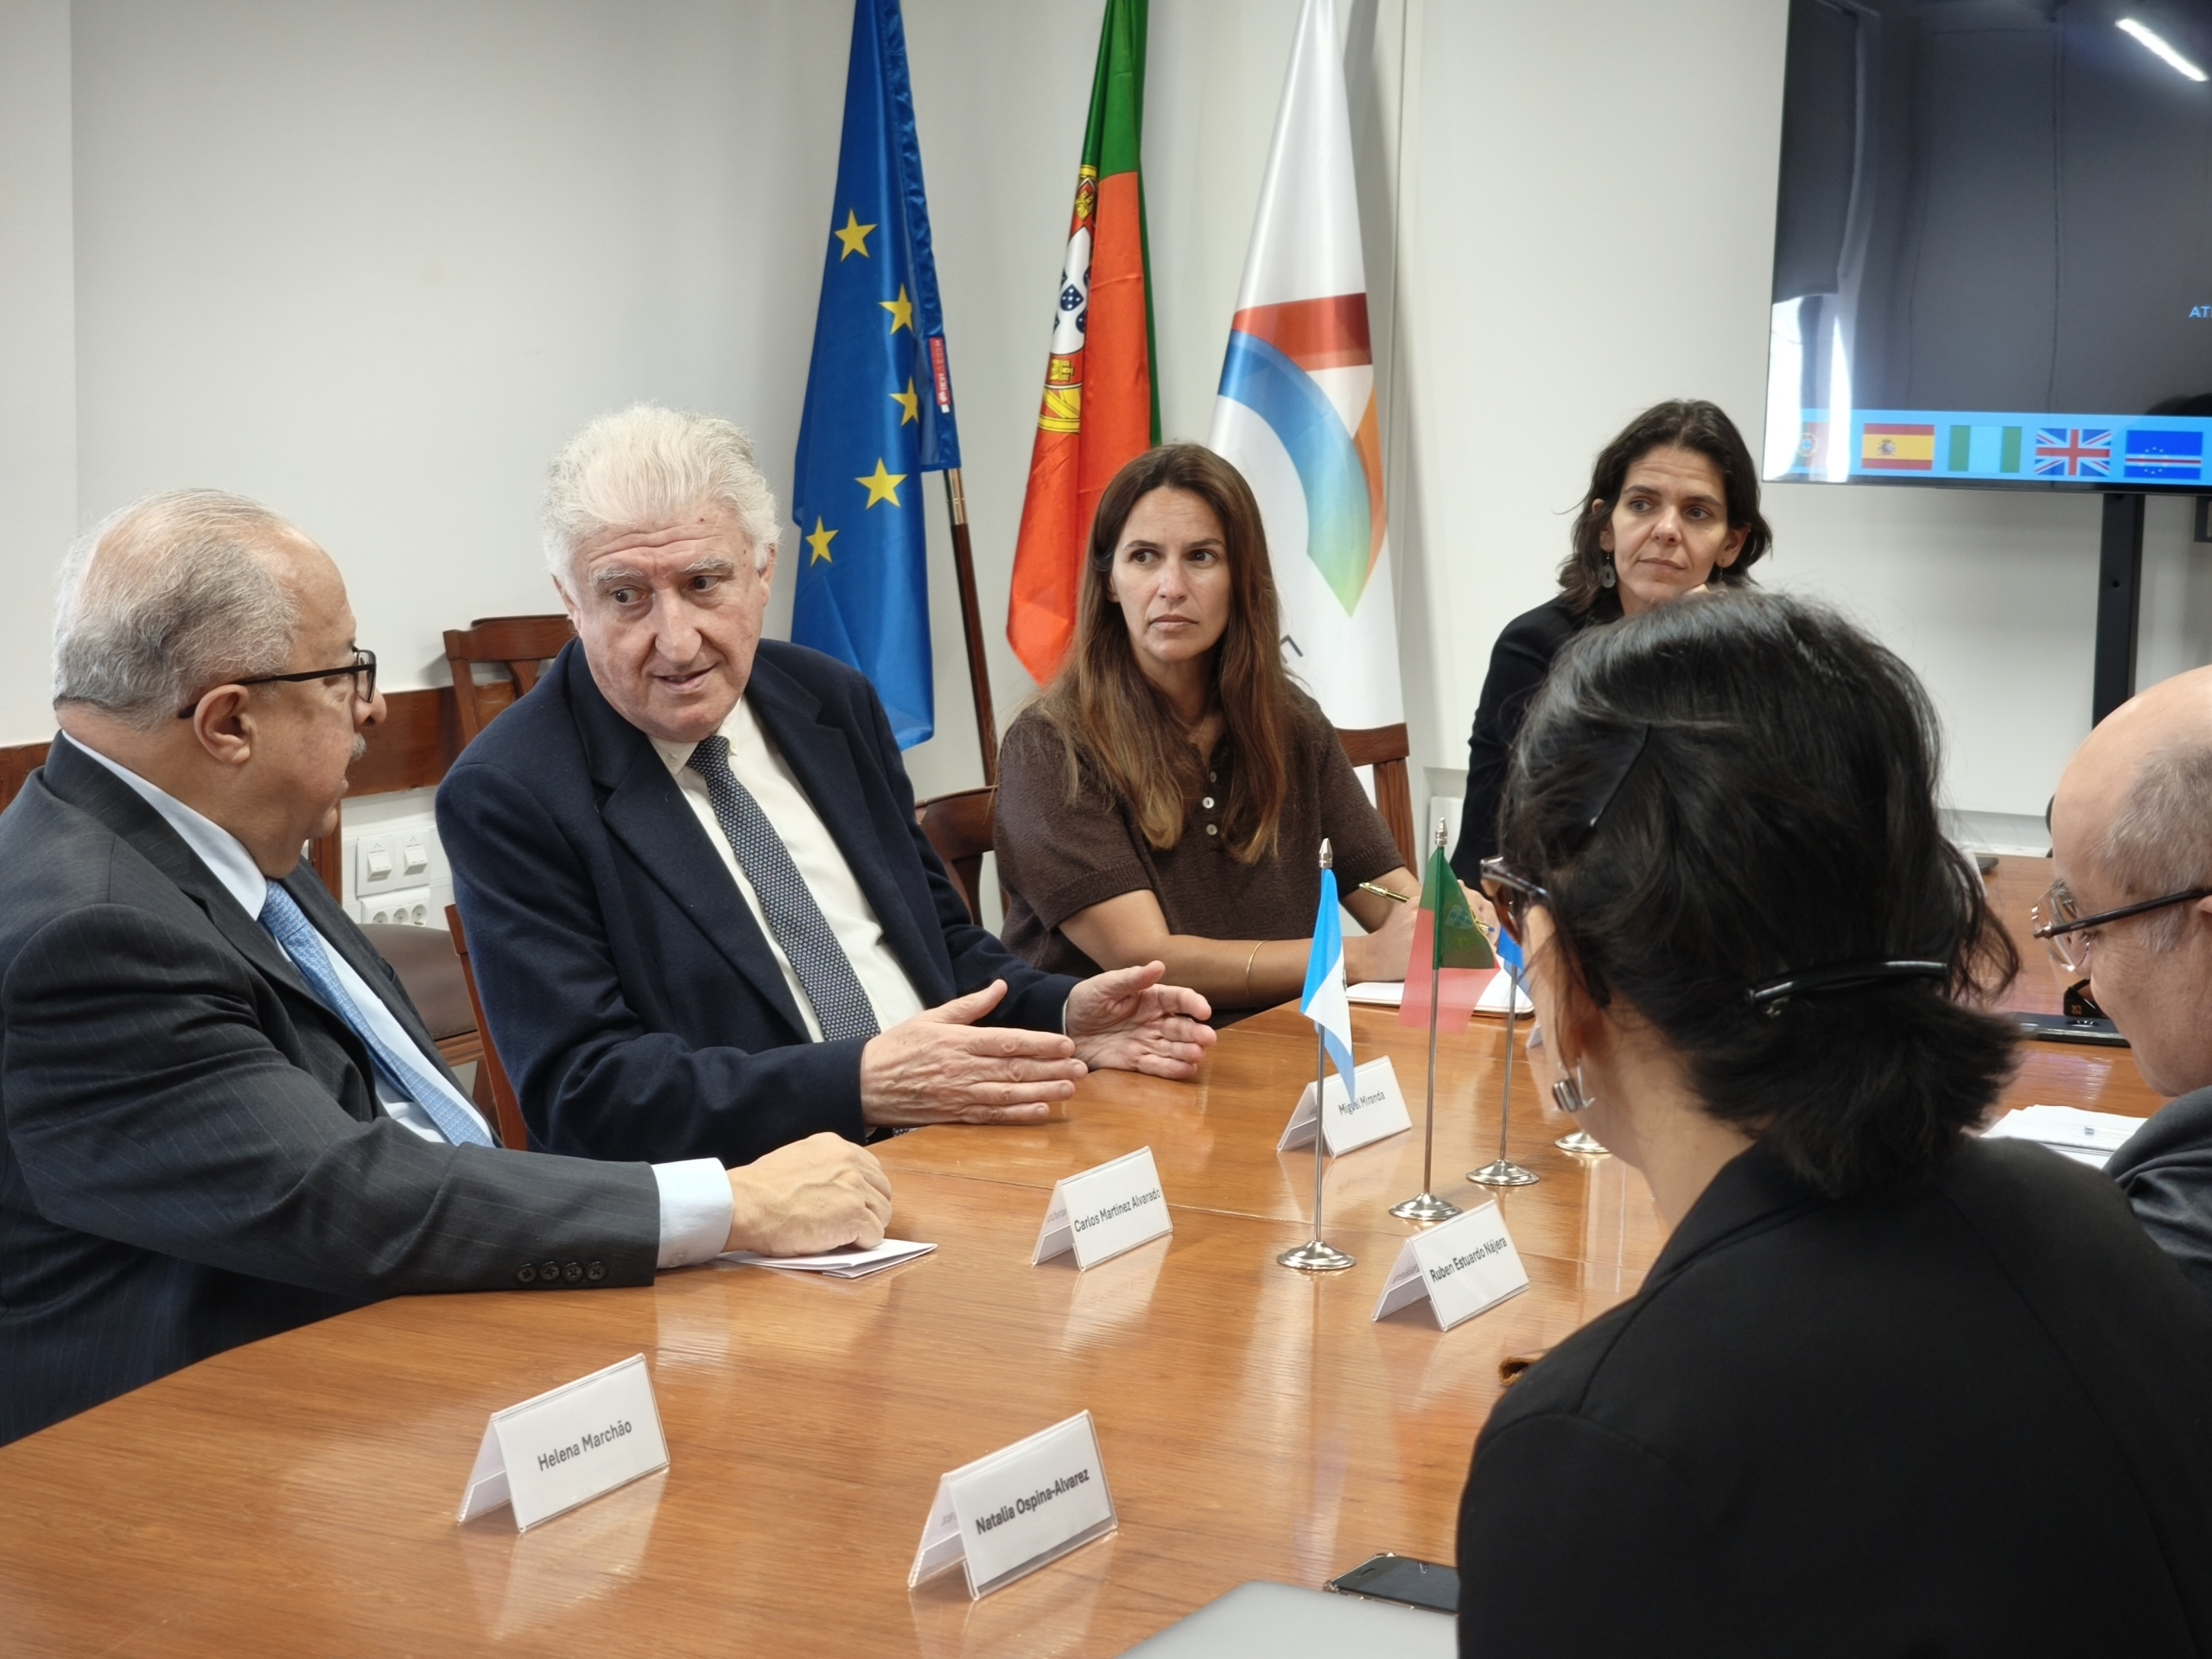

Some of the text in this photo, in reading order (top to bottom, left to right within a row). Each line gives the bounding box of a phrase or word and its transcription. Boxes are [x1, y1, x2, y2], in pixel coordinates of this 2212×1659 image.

[2189, 305, 2212, 318] AT
[1359, 1090, 1386, 1108] Miranda
[1074, 1214, 1101, 1233] Carlos
[1131, 1188, 1161, 1209] Alvarado
[1429, 1262, 1455, 1283] Ruben
[1452, 1247, 1485, 1271] Estuardo
[1483, 1237, 1508, 1255] Nájera
[537, 1420, 632, 1471] Helena Marchão
[975, 1468, 1090, 1535] Natalia Ospina-Alvarez
